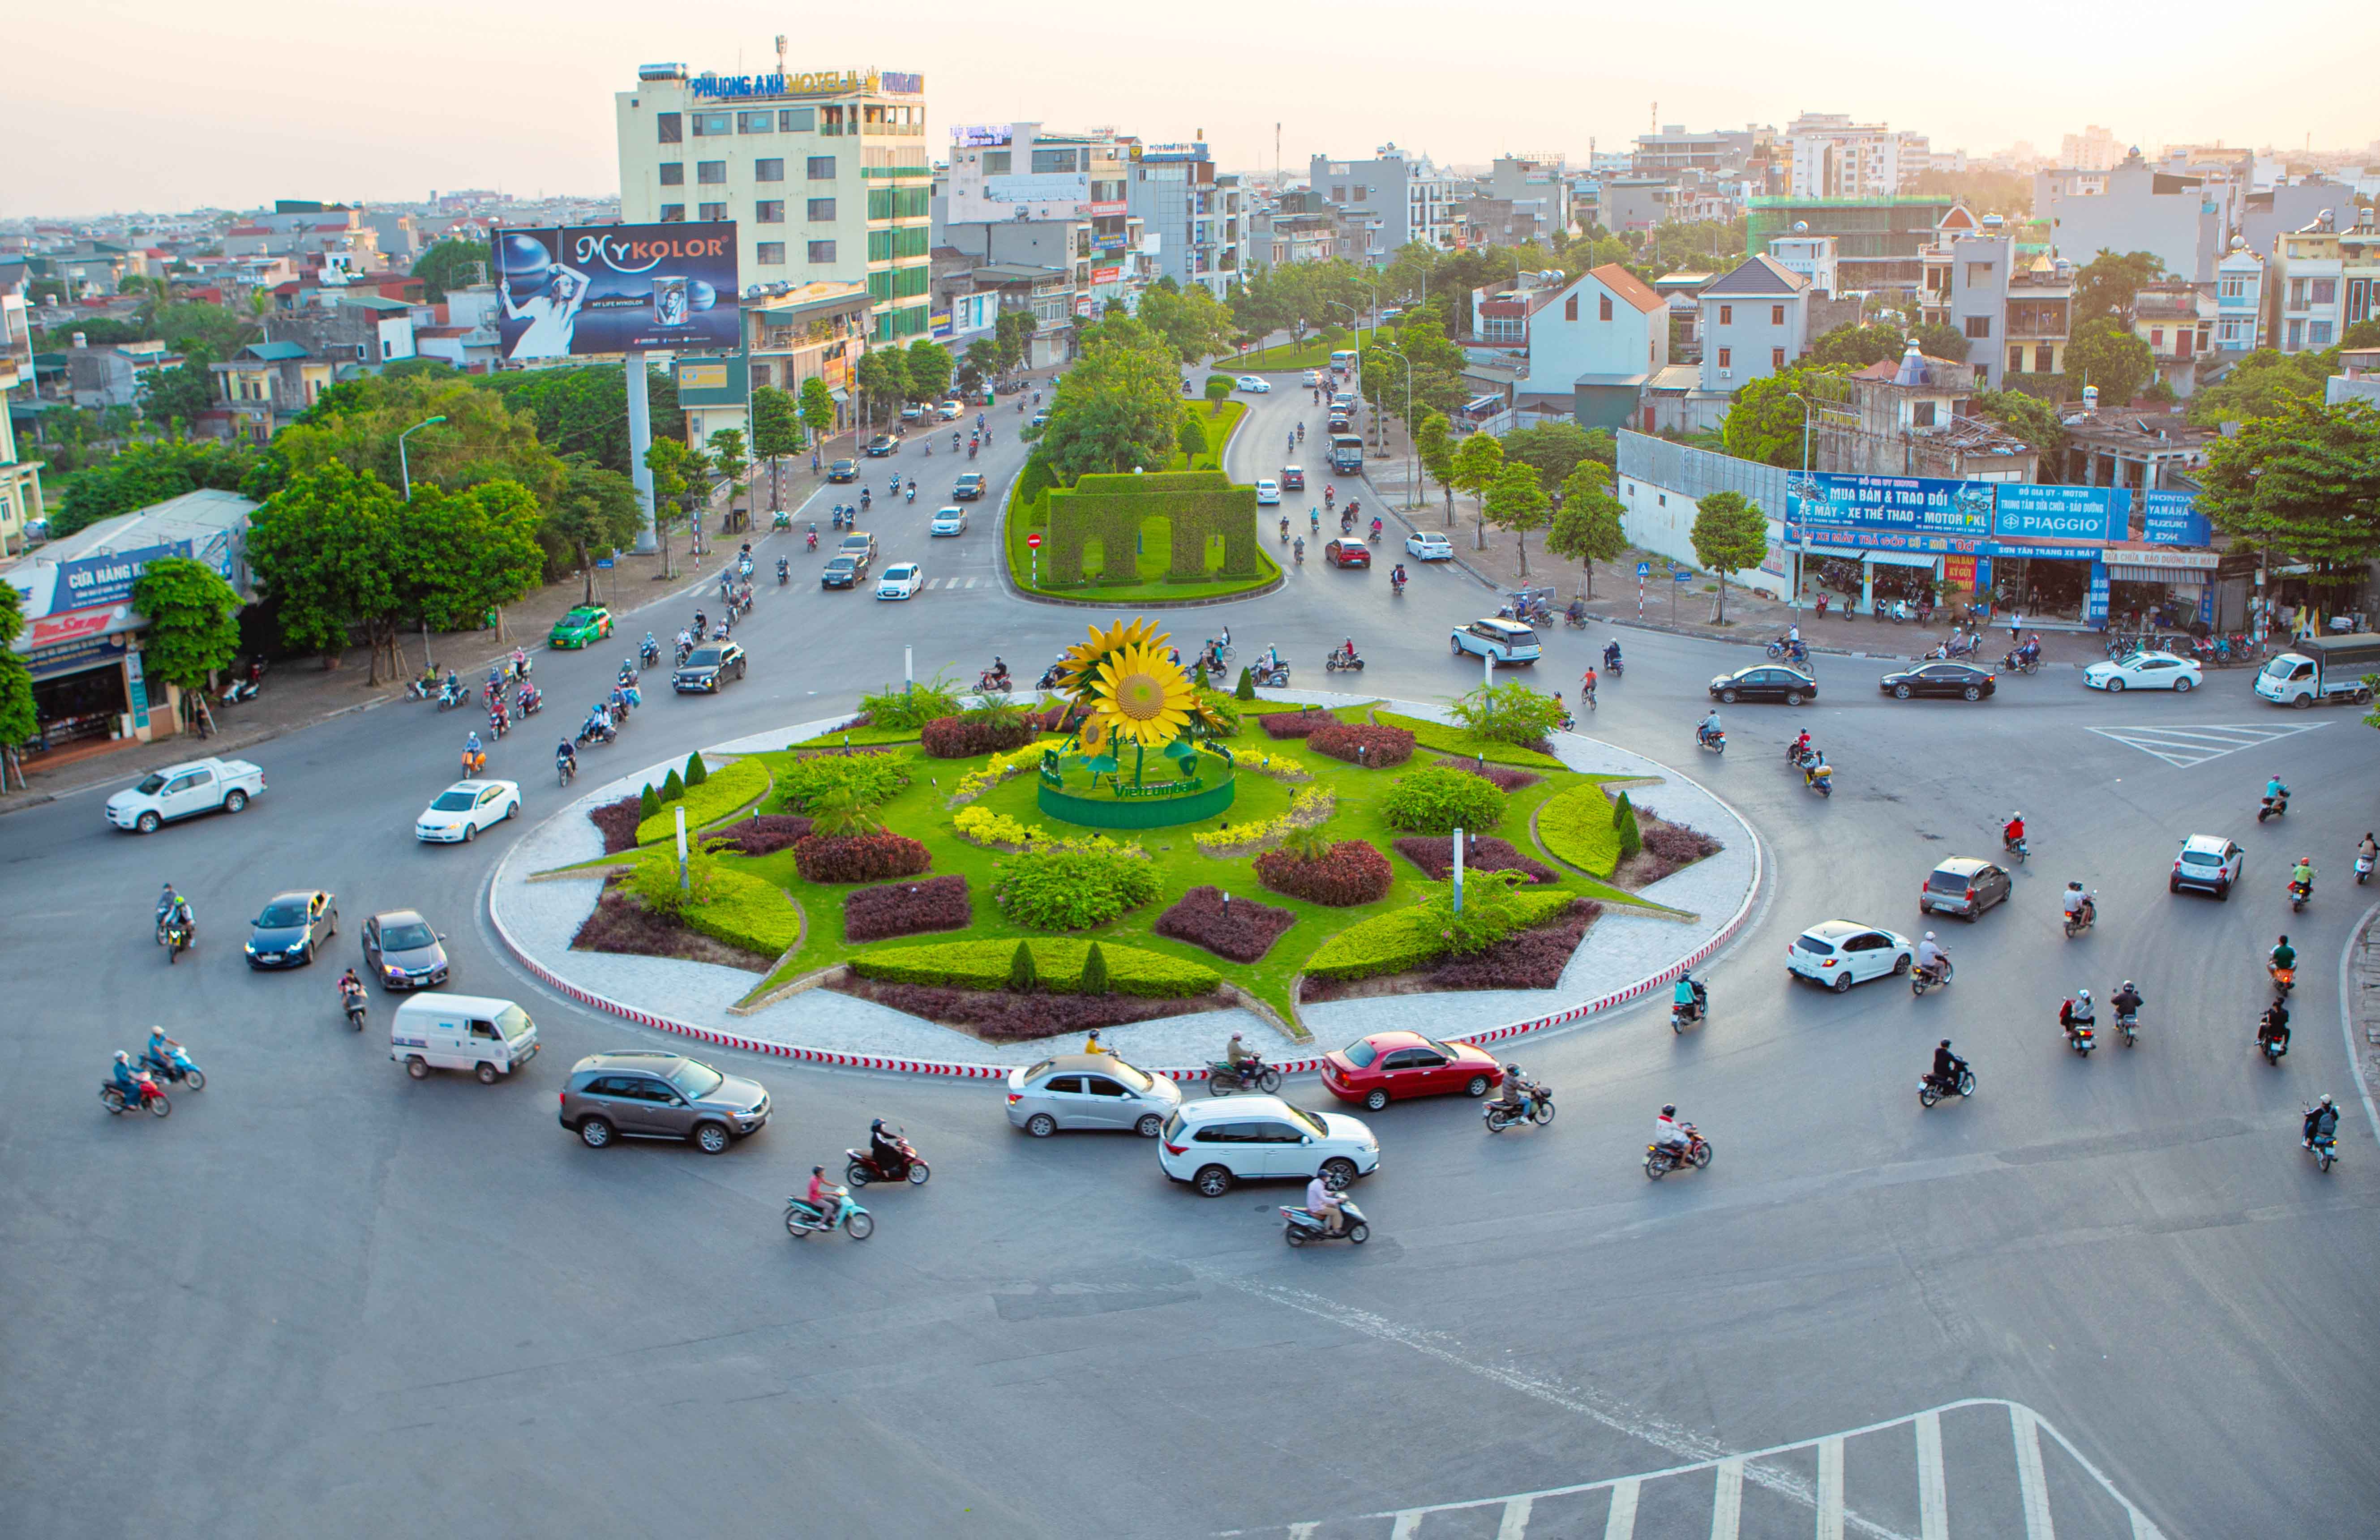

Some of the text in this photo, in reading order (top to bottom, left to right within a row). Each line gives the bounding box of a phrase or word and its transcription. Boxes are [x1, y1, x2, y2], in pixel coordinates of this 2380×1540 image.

[755, 73, 784, 95] ANH
[786, 71, 845, 94] HOTEL
[1830, 487, 1855, 501] MUA
[1859, 487, 1881, 503] BÁN
[1884, 490, 1892, 503] &
[1895, 491, 1924, 505] TRAO
[2063, 490, 2089, 498] MOTOR
[2149, 494, 2193, 502] HONDA
[2001, 500, 2020, 510] TRUNG
[2149, 505, 2189, 516] YAMAHA
[1848, 507, 1861, 518] XE
[1864, 505, 1885, 520] THỂ
[1886, 510, 1913, 522] THAO
[1924, 512, 1963, 525] MOTOR
[1965, 515, 1987, 527] PKL
[2023, 516, 2098, 531] PIAGGIO
[2147, 519, 2188, 529] SUZUKI
[1793, 530, 1814, 539] BN
[1816, 532, 1829, 541] XE
[2154, 532, 2178, 542] SYM
[2188, 557, 2197, 565] XE
[69, 567, 94, 589] CỬA
[96, 563, 130, 584] HÀNG
[1113, 777, 1204, 798] Vietcombank
